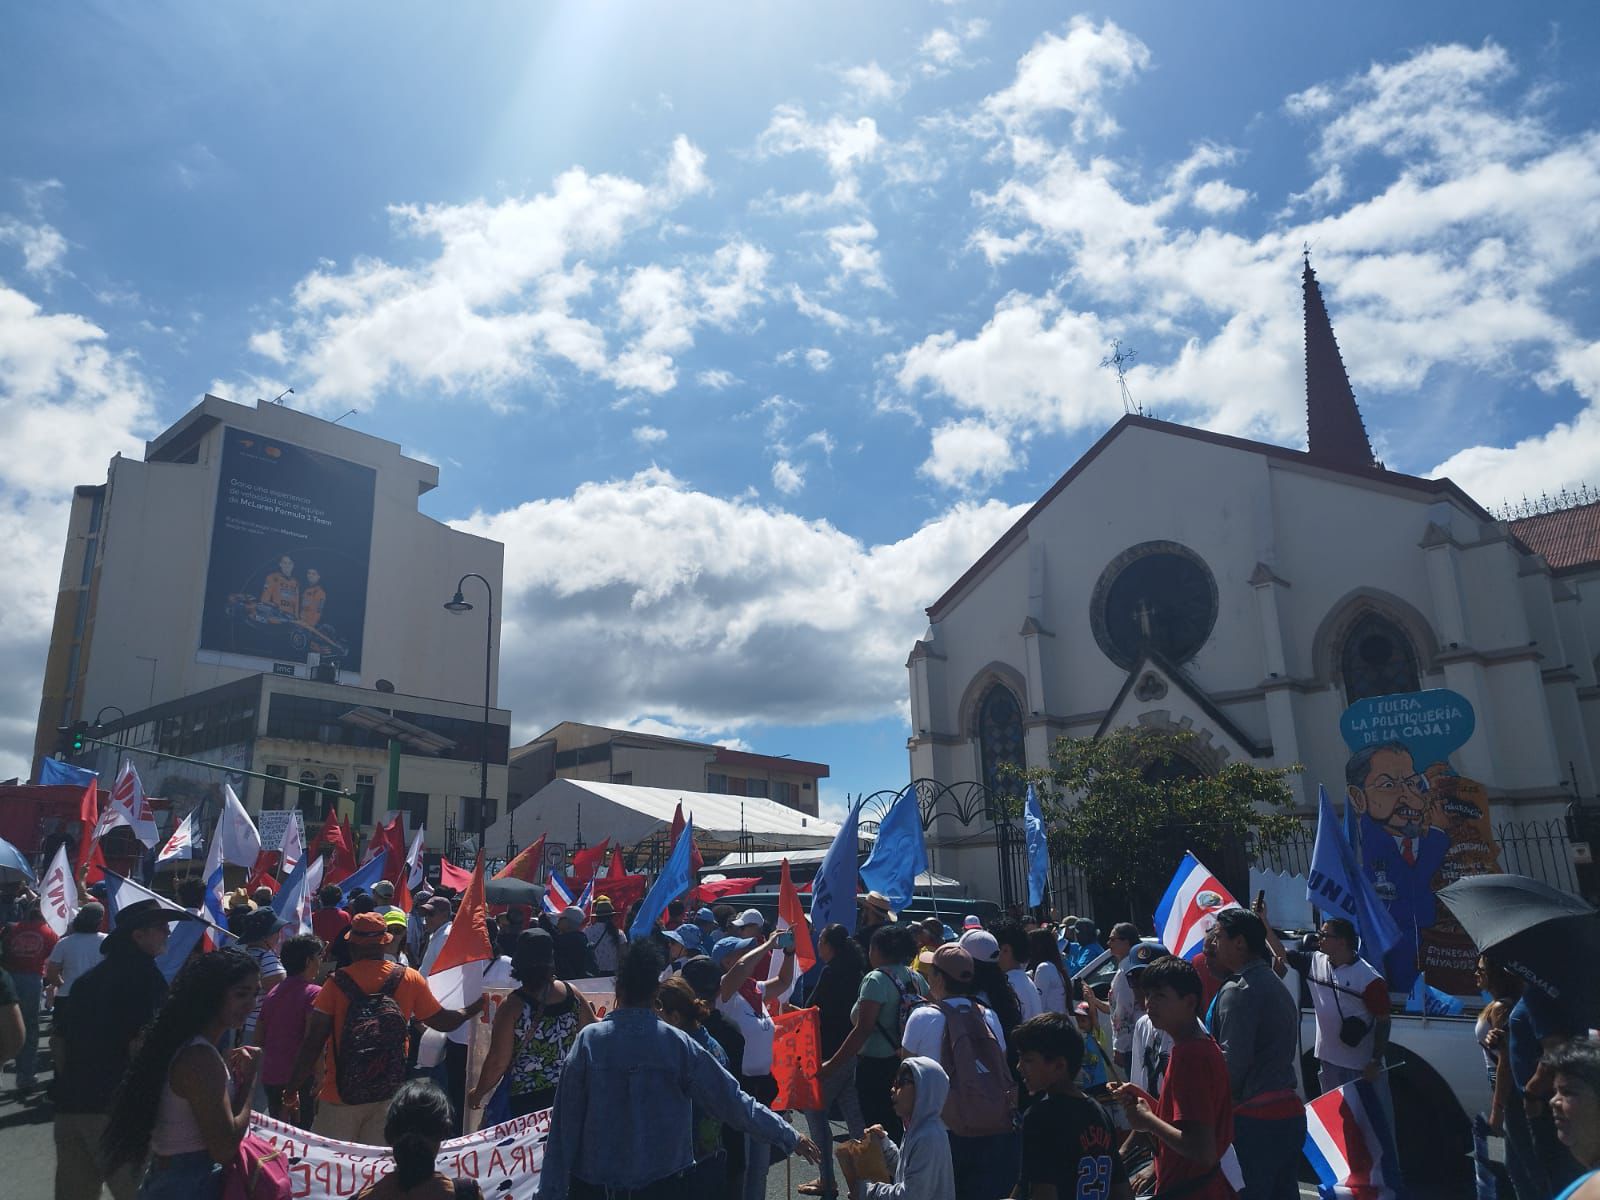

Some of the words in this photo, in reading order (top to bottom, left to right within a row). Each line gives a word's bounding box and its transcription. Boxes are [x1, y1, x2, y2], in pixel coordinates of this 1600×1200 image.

[240, 498, 274, 512] McLaren
[275, 506, 306, 520] Formula
[313, 516, 333, 527] Team
[1351, 718, 1368, 731] LA
[1364, 730, 1379, 744] DE
[1383, 728, 1400, 741] LA
